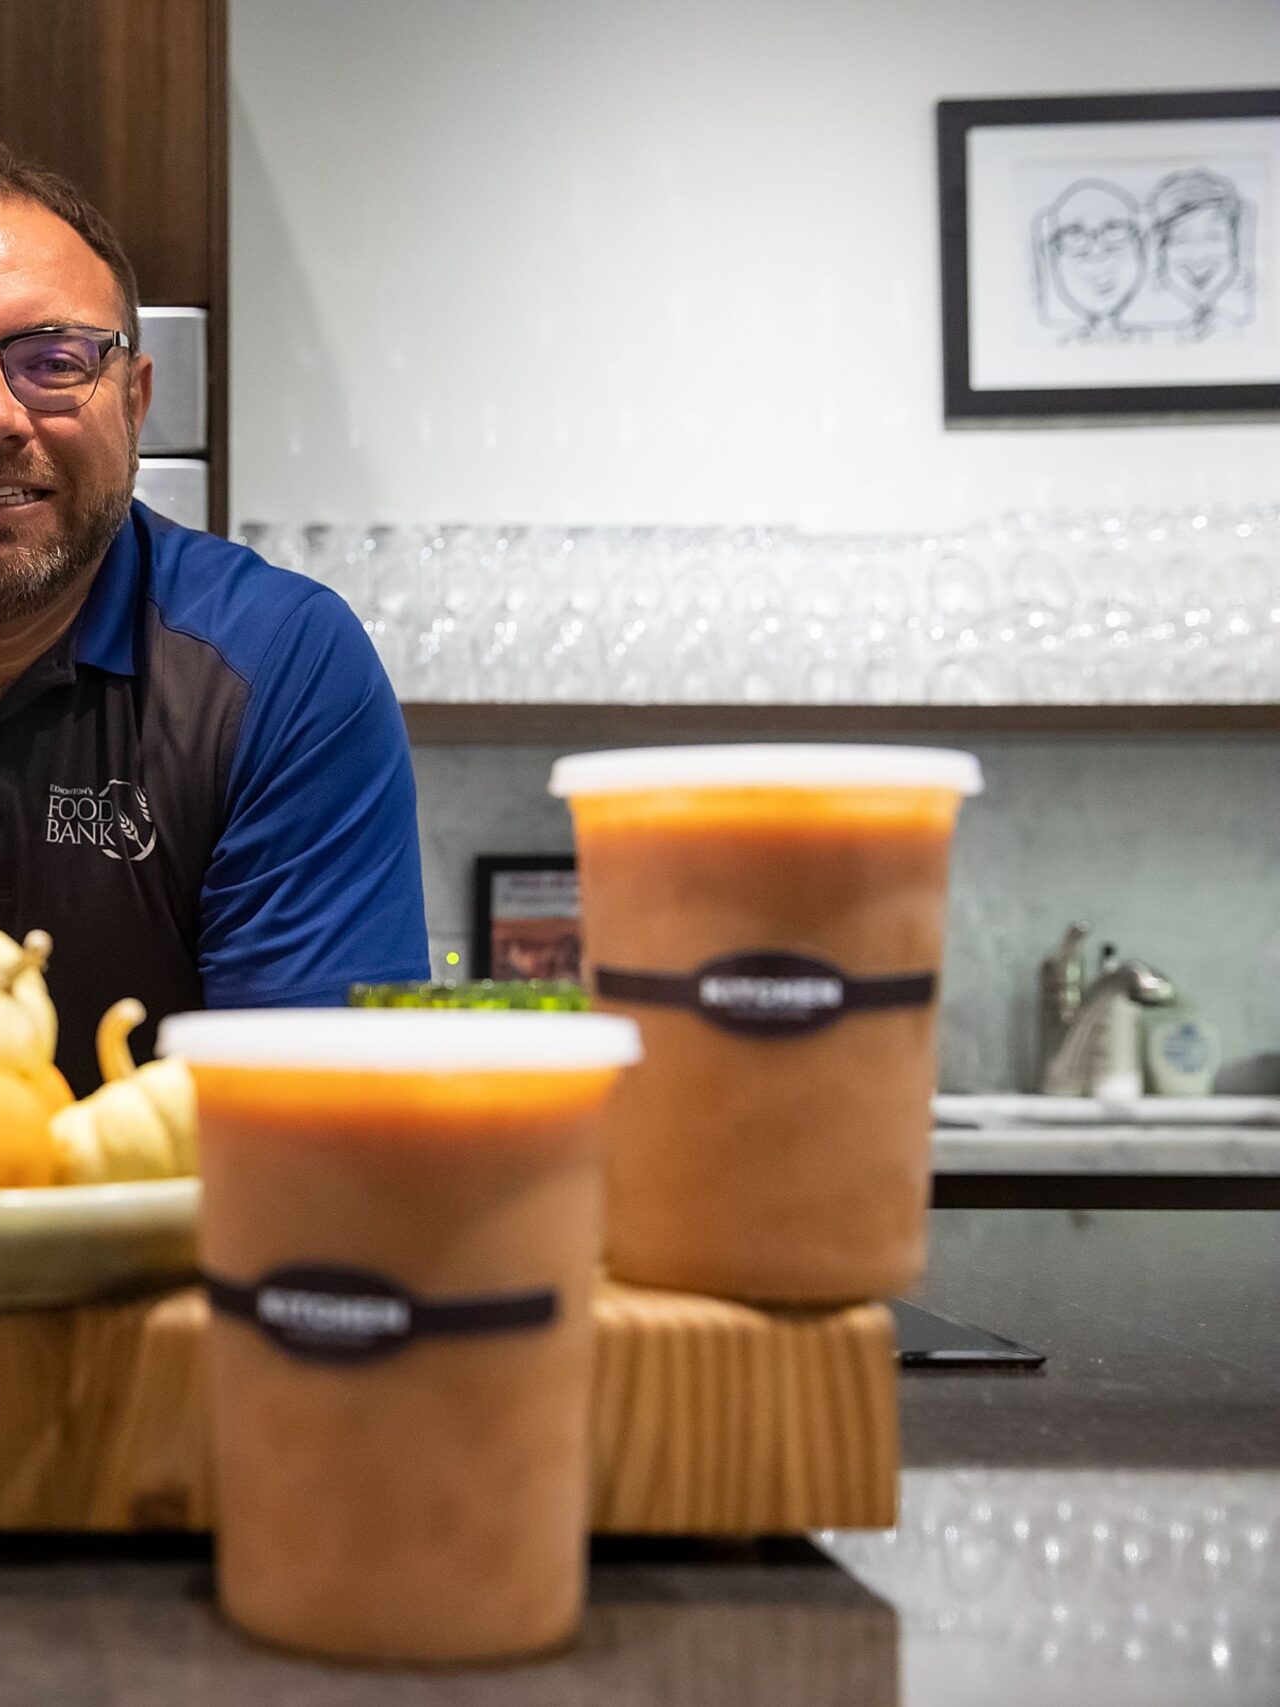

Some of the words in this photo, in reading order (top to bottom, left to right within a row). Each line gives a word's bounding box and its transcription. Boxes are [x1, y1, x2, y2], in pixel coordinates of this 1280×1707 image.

[47, 795, 113, 822] FOOD
[45, 819, 116, 846] BANK
[699, 976, 844, 1009] KITCHEN
